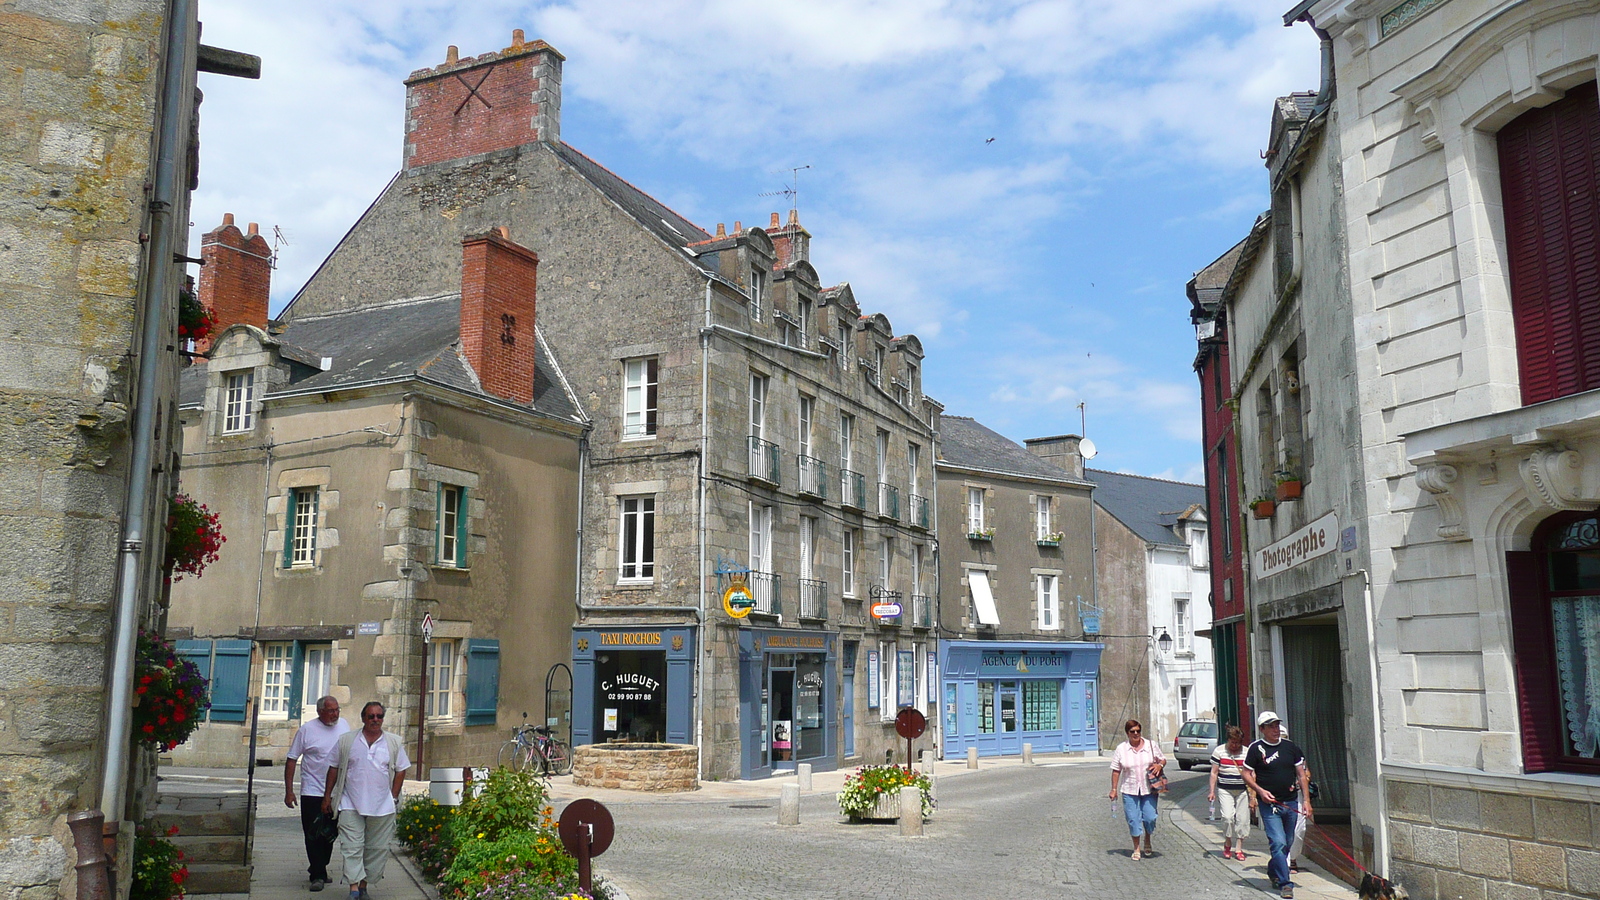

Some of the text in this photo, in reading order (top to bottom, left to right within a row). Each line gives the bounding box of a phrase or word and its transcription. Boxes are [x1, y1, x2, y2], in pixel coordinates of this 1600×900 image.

[1262, 527, 1326, 571] Photographe
[601, 632, 661, 645] TAXI ROCHOIS
[982, 656, 1062, 667] AGENCE DU PORT
[601, 673, 660, 692] C. HUGUET
